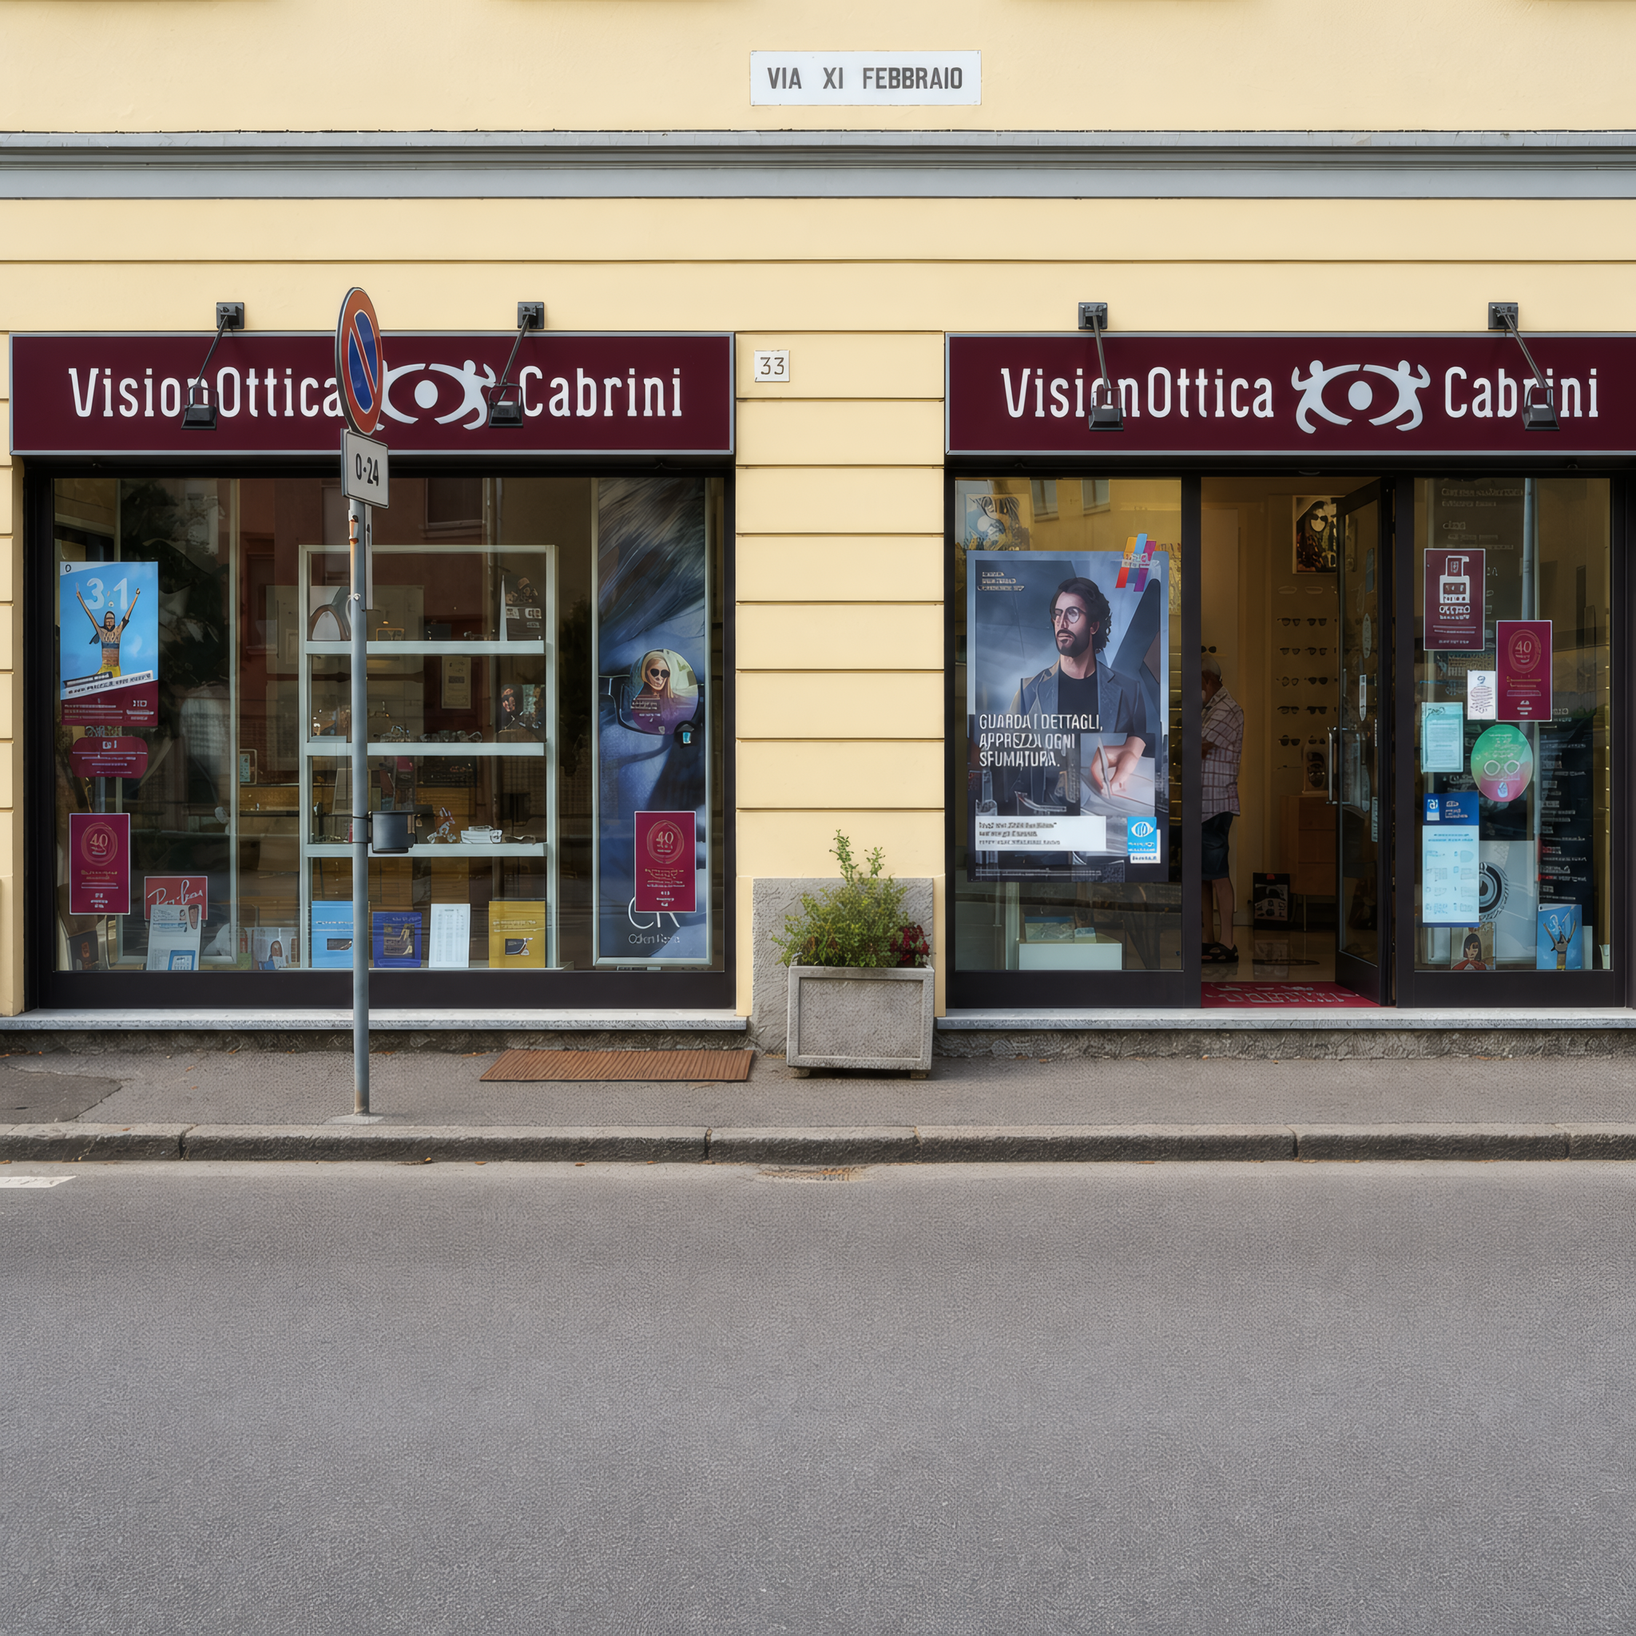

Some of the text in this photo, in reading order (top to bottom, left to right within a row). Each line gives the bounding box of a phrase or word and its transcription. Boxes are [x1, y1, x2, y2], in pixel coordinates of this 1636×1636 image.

[767, 67, 963, 89] VIA XI FEBBRAIO
[760, 356, 784, 375] 33
[519, 365, 682, 417] Cabrini
[1515, 641, 1532, 654] 40
[90, 833, 108, 846] 40
[656, 832, 674, 845] 40
